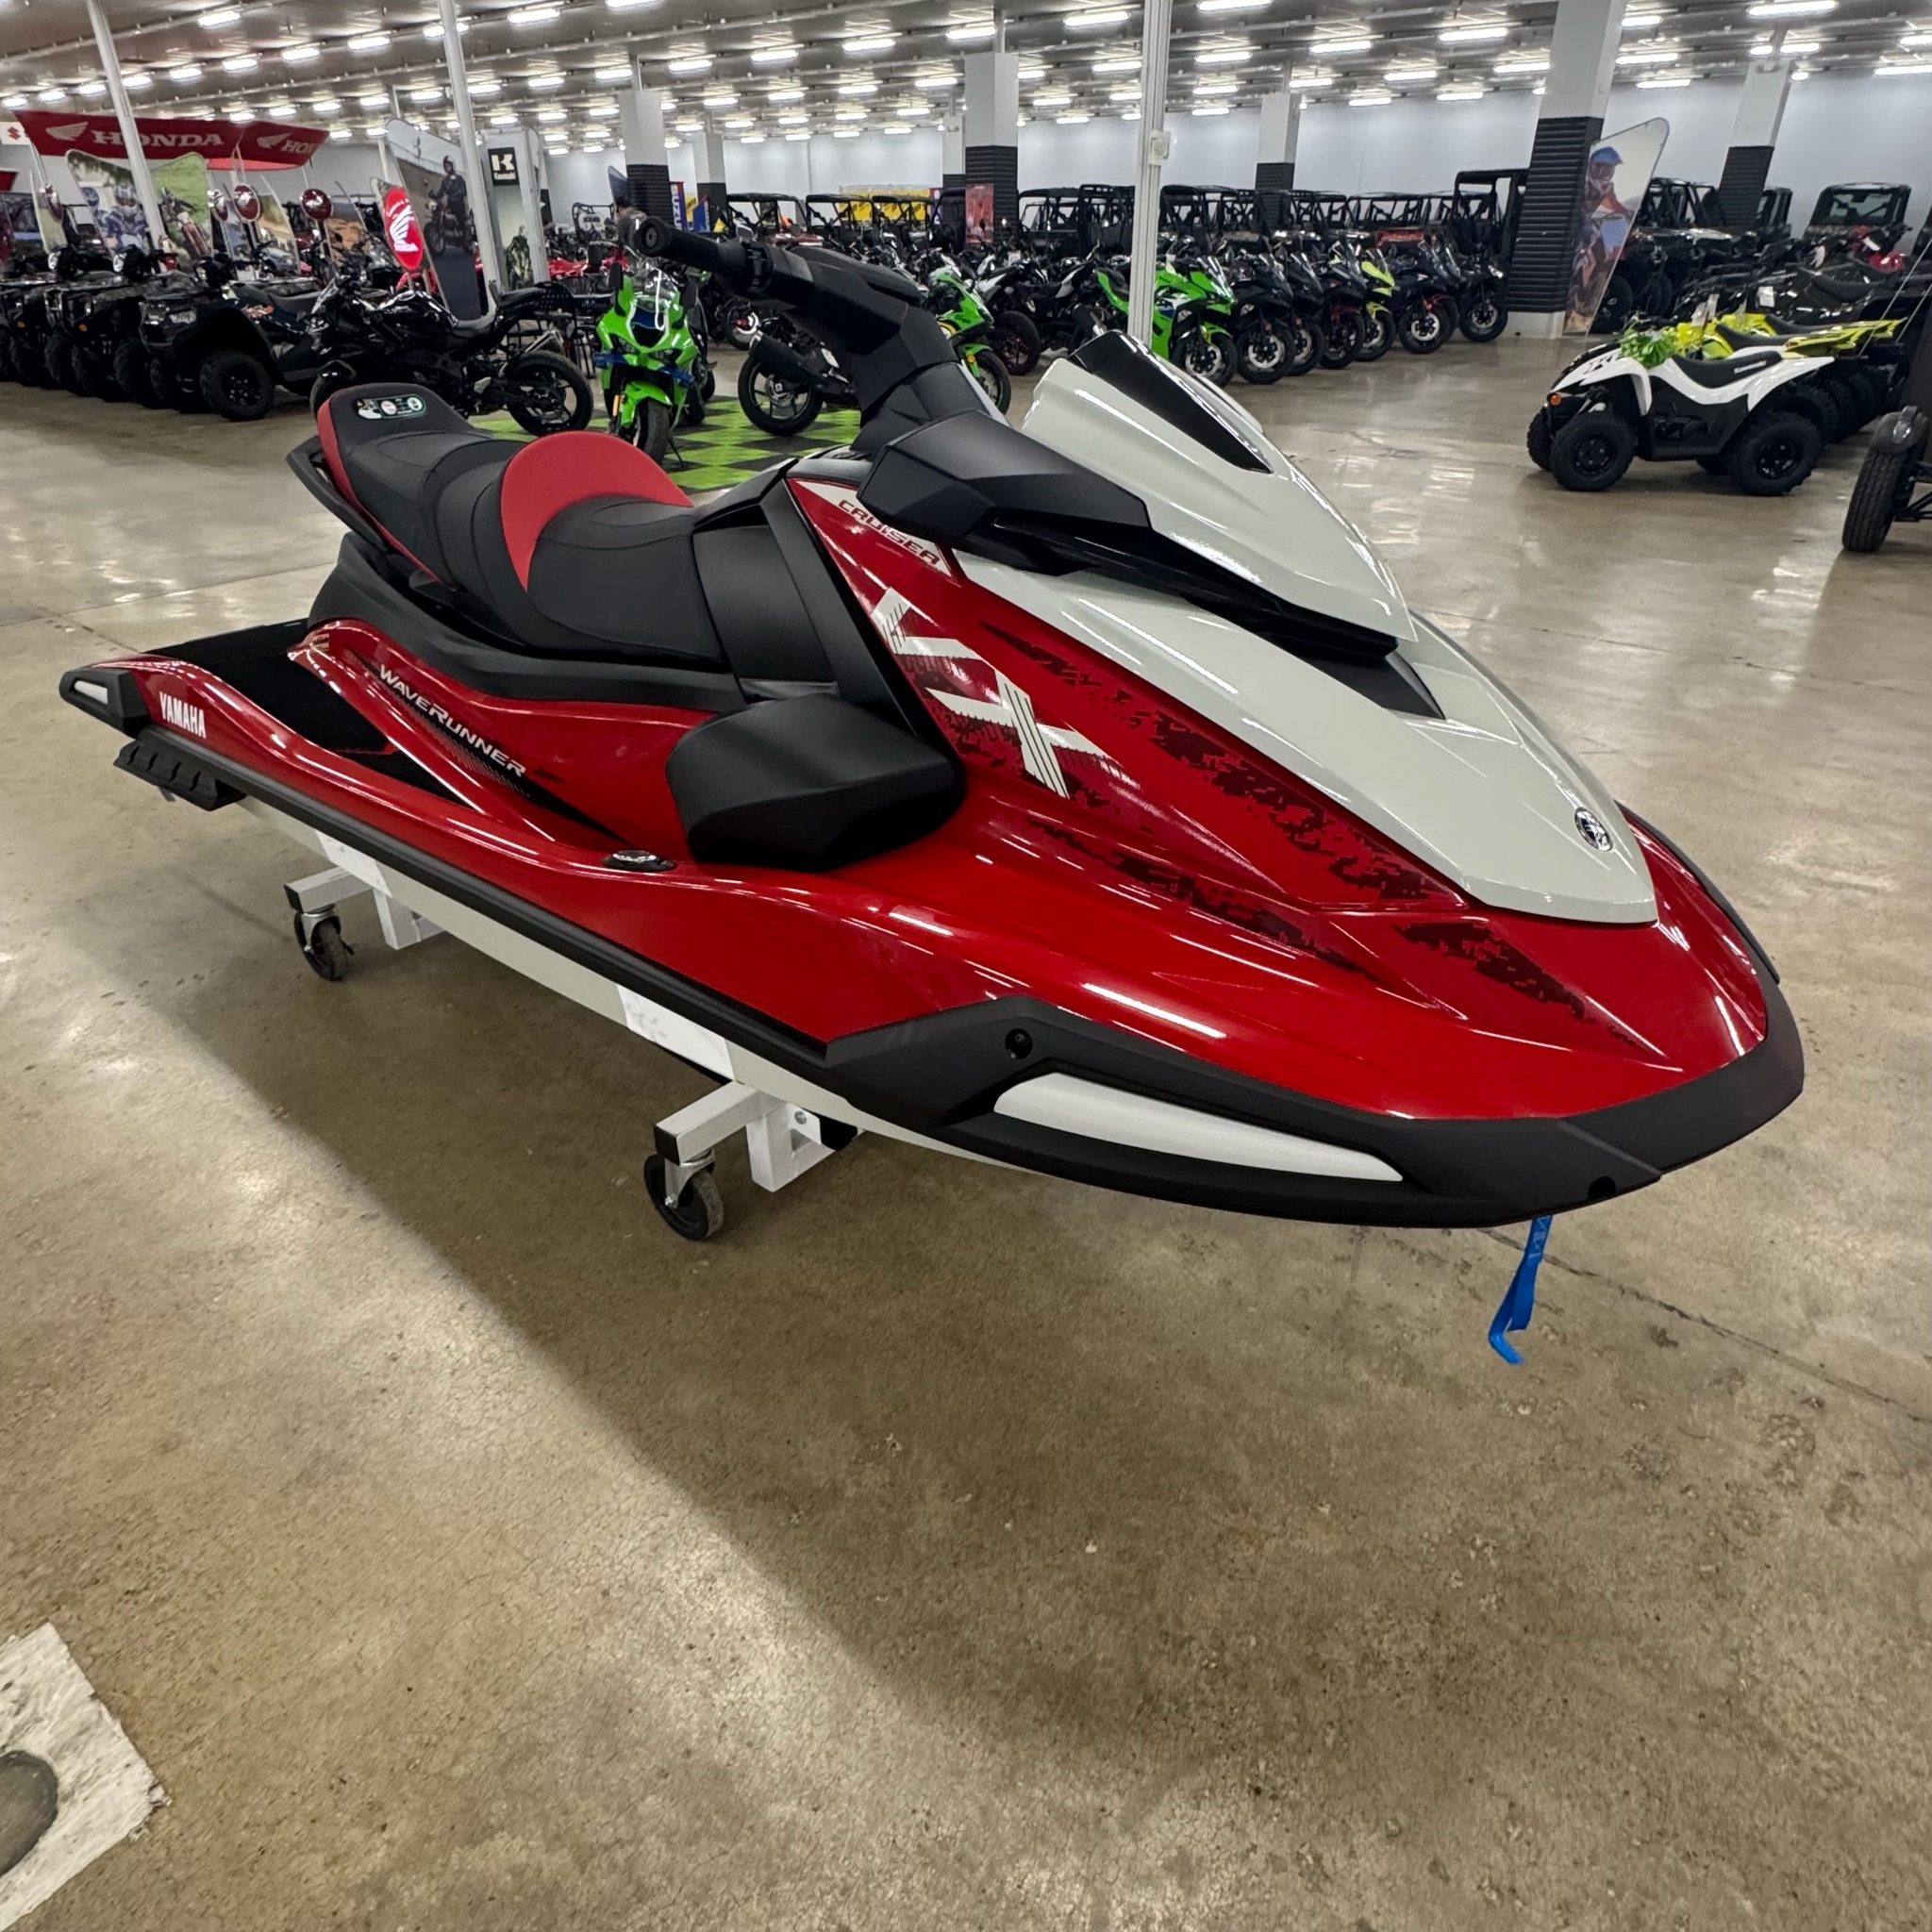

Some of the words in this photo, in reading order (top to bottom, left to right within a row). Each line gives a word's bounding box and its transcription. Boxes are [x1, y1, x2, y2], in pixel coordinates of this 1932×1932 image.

[838, 499, 941, 565] CRUISER
[158, 691, 207, 739] YAMAHA
[379, 664, 526, 777] WAVERUNNER
